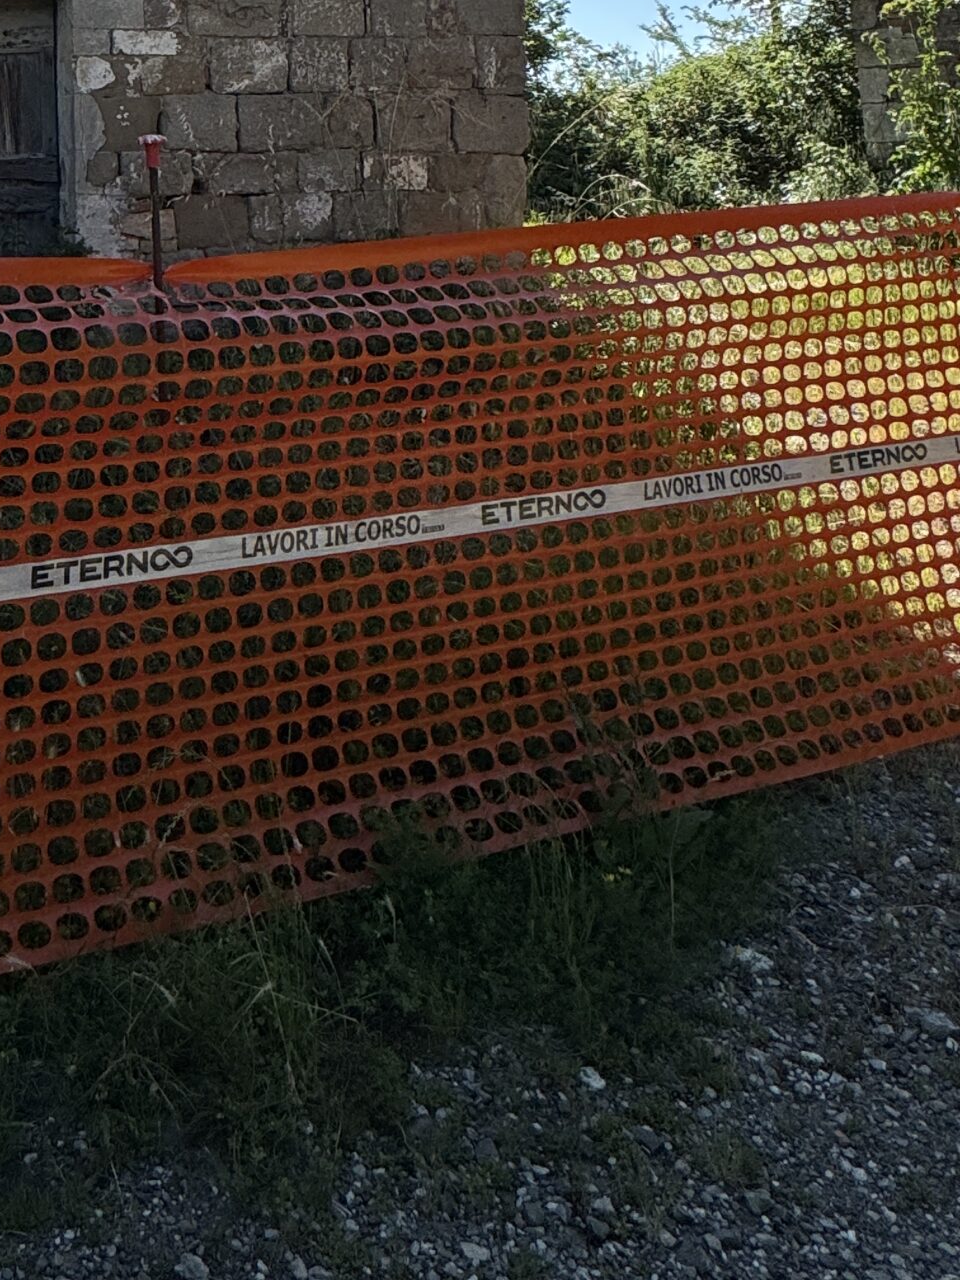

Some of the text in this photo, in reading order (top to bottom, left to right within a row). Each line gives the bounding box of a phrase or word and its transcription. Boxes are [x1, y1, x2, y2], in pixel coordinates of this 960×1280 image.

[644, 463, 782, 500] LAVORI IN CORSO
[241, 515, 421, 558] LAVORI IN CORSO
